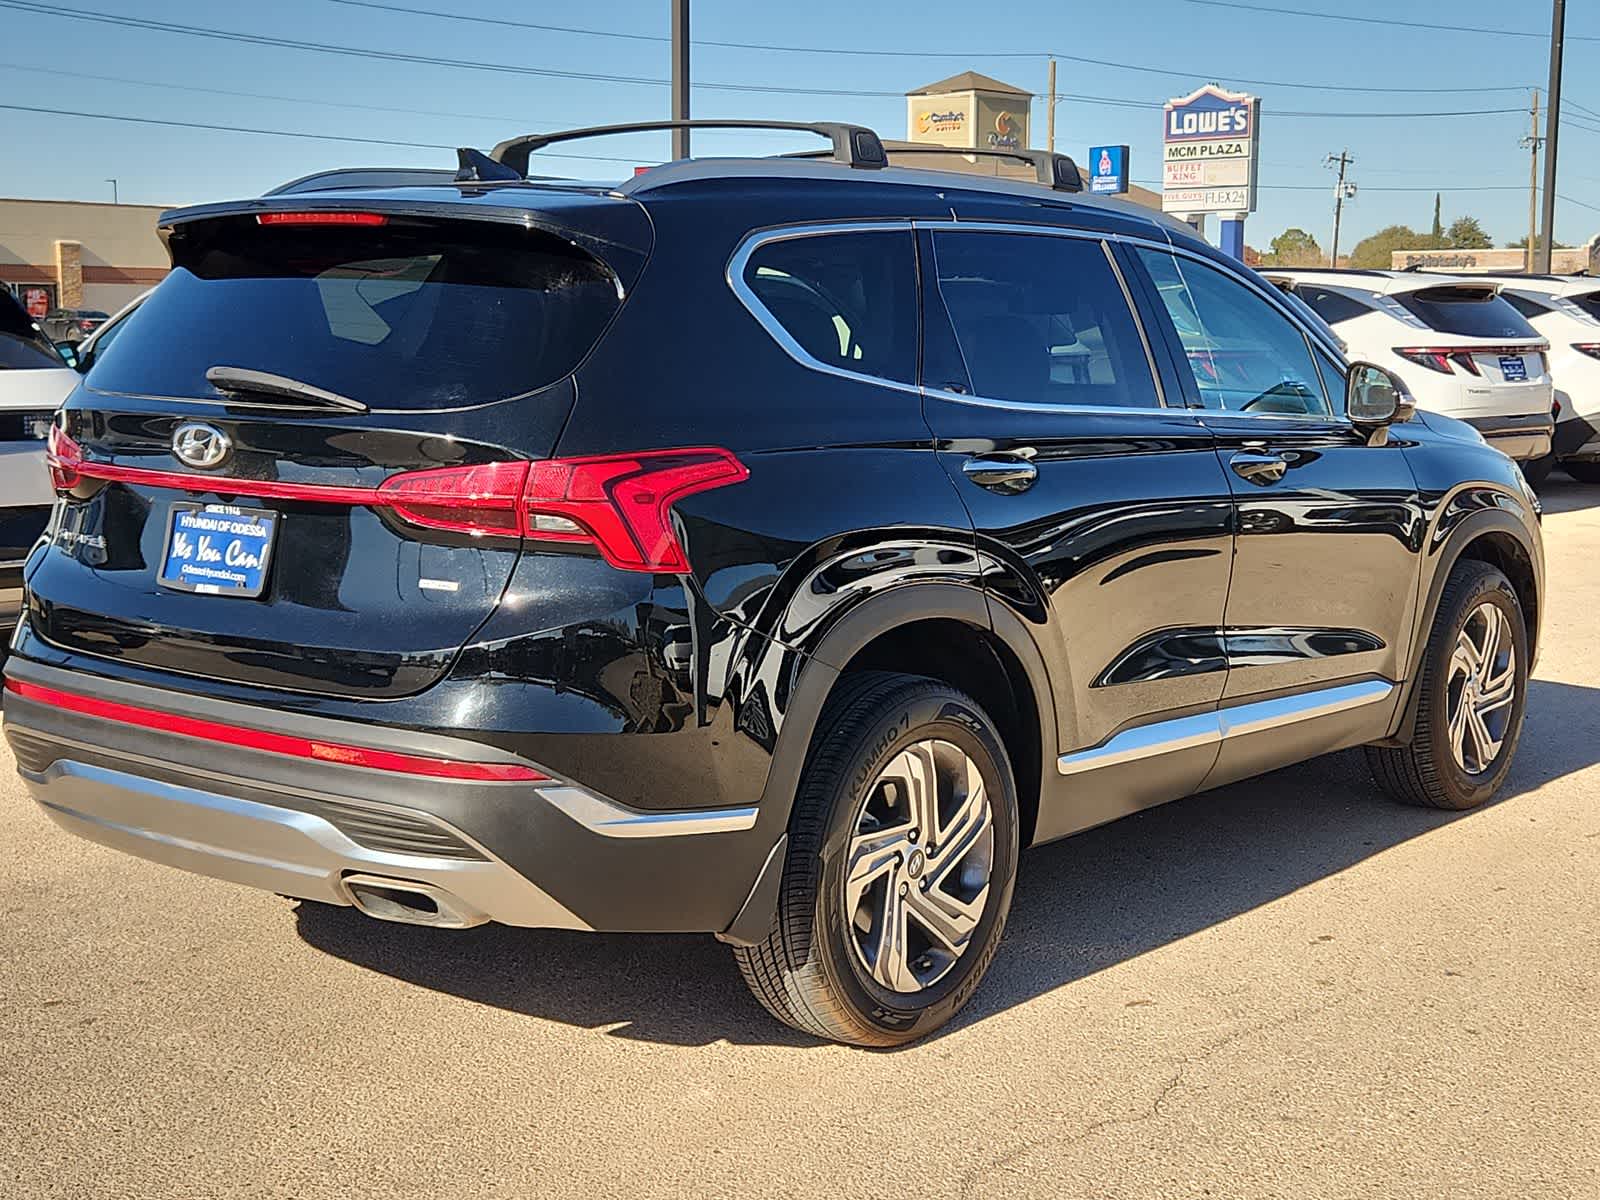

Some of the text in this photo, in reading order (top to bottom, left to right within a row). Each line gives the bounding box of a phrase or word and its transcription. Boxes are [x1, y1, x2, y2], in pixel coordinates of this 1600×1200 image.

[1170, 107, 1247, 135] LOWE'S
[1168, 143, 1242, 158] MCM PLAZA
[1167, 163, 1202, 173] BUFFET
[1172, 172, 1196, 180] KING
[1181, 192, 1202, 200] GUYS
[1205, 190, 1245, 205] FLEX24
[181, 515, 267, 537] HYUNDAI OF ODESSA
[172, 532, 193, 560] Yes
[196, 535, 222, 562] You
